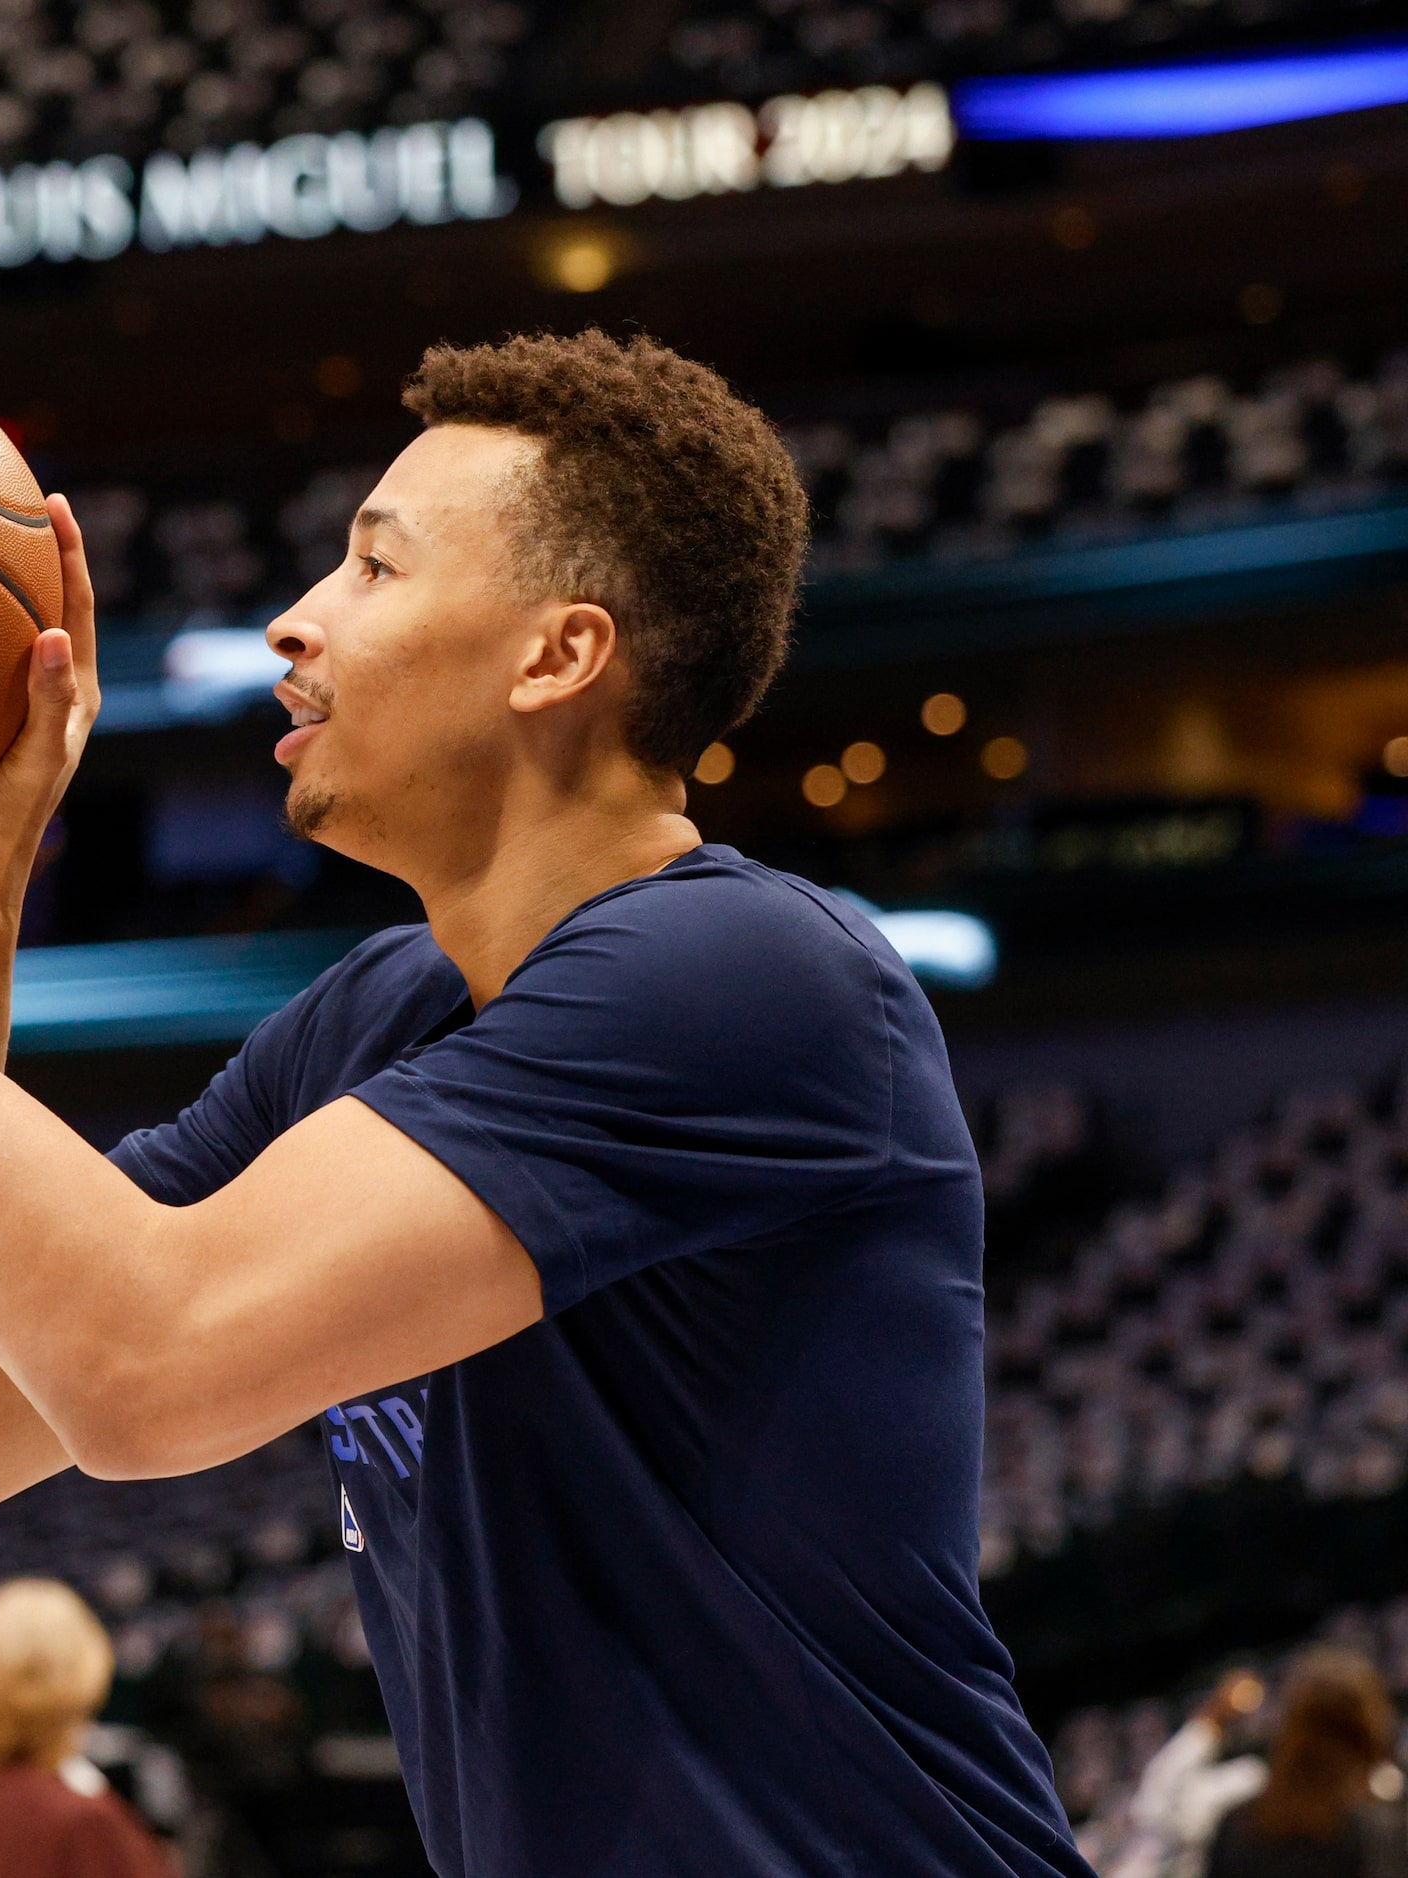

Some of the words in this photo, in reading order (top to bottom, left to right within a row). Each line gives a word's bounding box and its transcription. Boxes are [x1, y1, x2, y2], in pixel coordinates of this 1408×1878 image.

[140, 117, 518, 254] MIGUEL
[537, 102, 760, 209] TOUR
[759, 82, 956, 189] 2024
